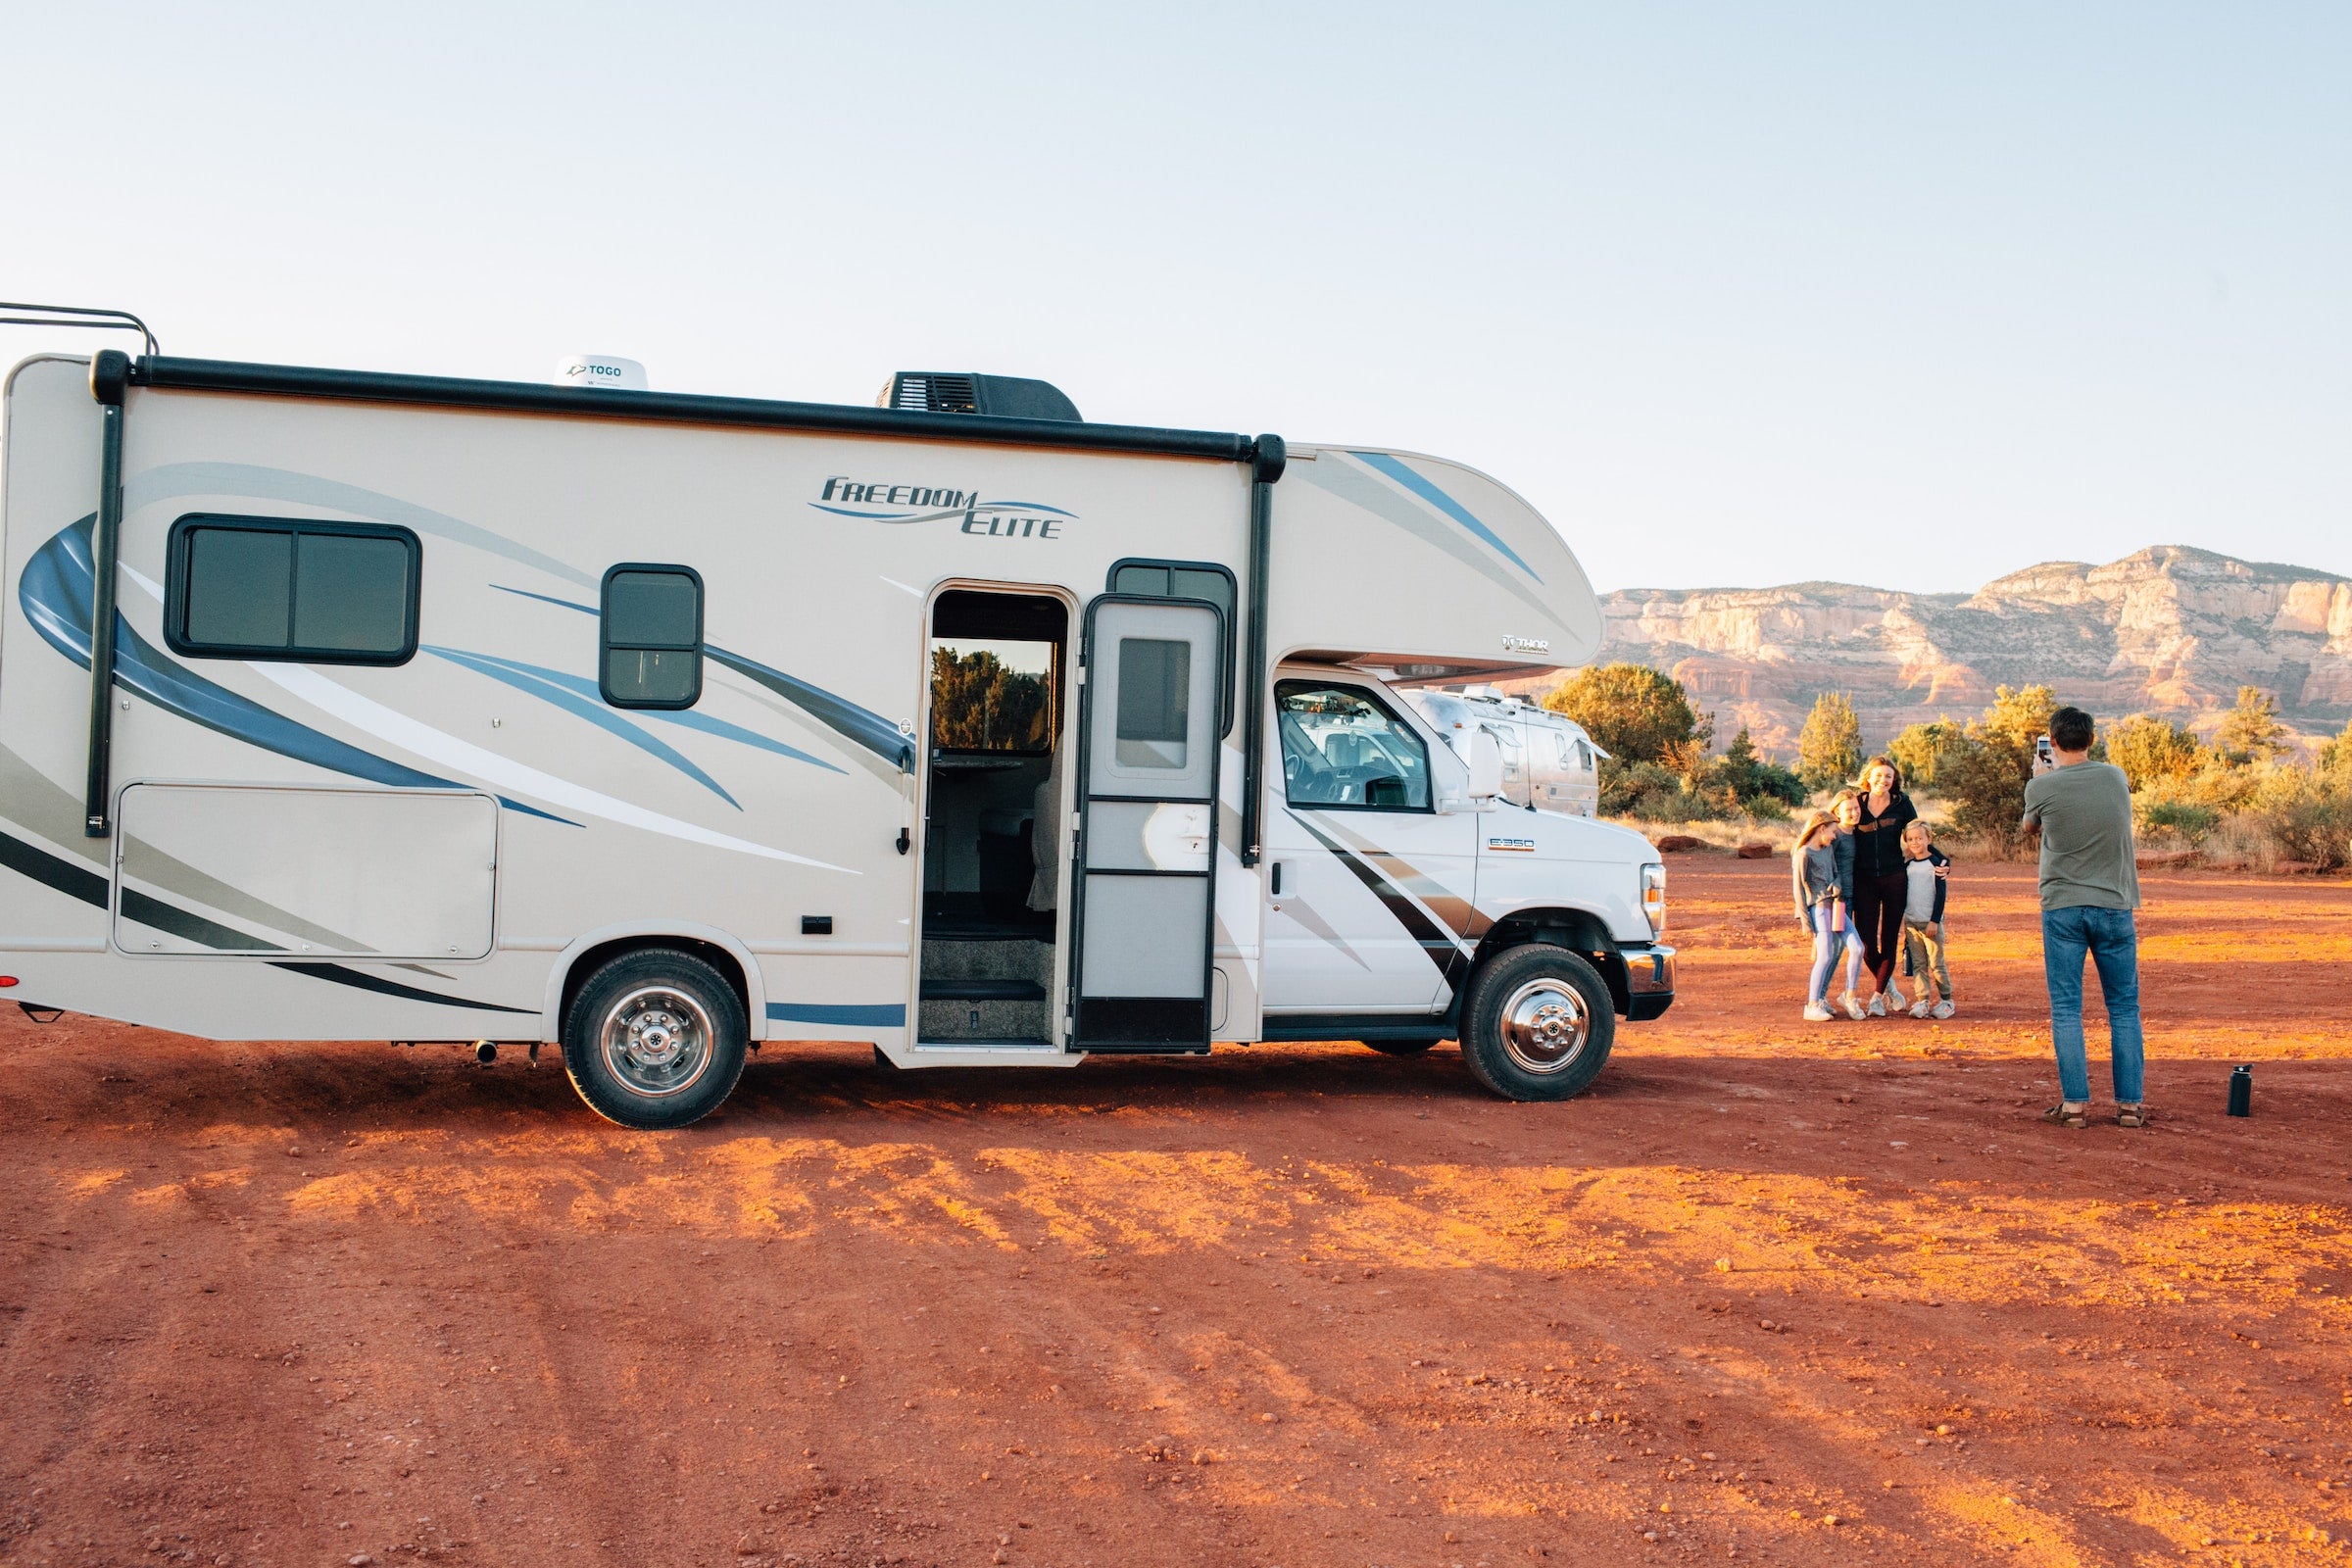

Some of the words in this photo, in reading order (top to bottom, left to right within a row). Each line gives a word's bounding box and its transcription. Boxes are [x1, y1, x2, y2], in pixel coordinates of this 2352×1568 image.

[589, 366, 622, 376] TOGO
[821, 476, 979, 510] FREEDOM
[961, 510, 1063, 539] ELITE
[1516, 638, 1548, 651] THOR
